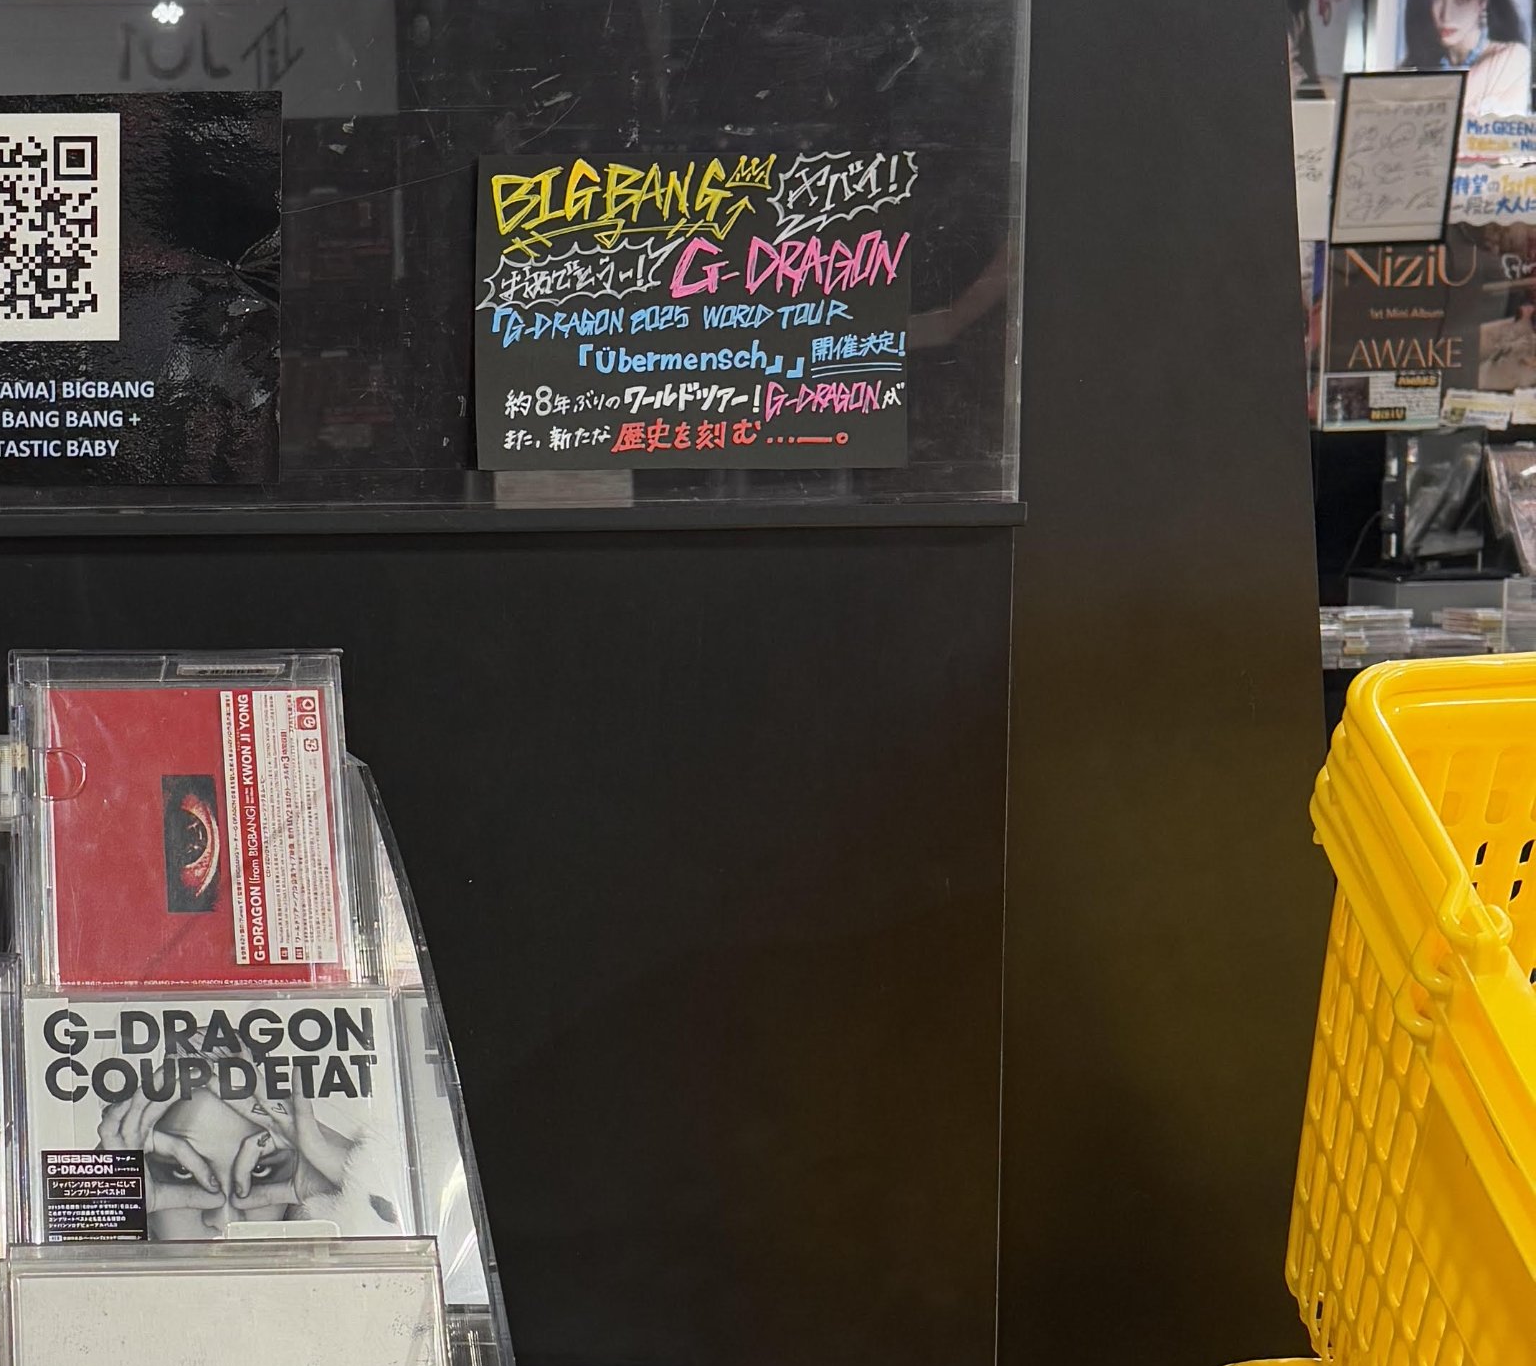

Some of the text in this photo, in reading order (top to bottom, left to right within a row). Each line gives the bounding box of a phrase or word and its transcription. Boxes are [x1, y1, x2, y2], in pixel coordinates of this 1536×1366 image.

[491, 157, 732, 235] BIGBANG
[671, 229, 910, 298] G-DRAGON
[1345, 244, 1477, 288] NiziU
[630, 306, 692, 333] 2025
[702, 304, 774, 331] WORLD
[777, 299, 854, 330] TOUR
[1348, 337, 1464, 368] AWAKE
[61, 380, 156, 399] BIGBANG
[1, 411, 56, 428] BANG
[65, 410, 120, 428] BANG
[67, 439, 120, 458] BABY
[236, 693, 251, 730] YONG
[239, 744, 254, 785] KWON
[250, 886, 267, 962] G-DRAGON
[43, 1007, 375, 1056] G-DRAGON
[44, 1057, 212, 1103] COUP
[47, 1164, 113, 1174] G-DRAGON
